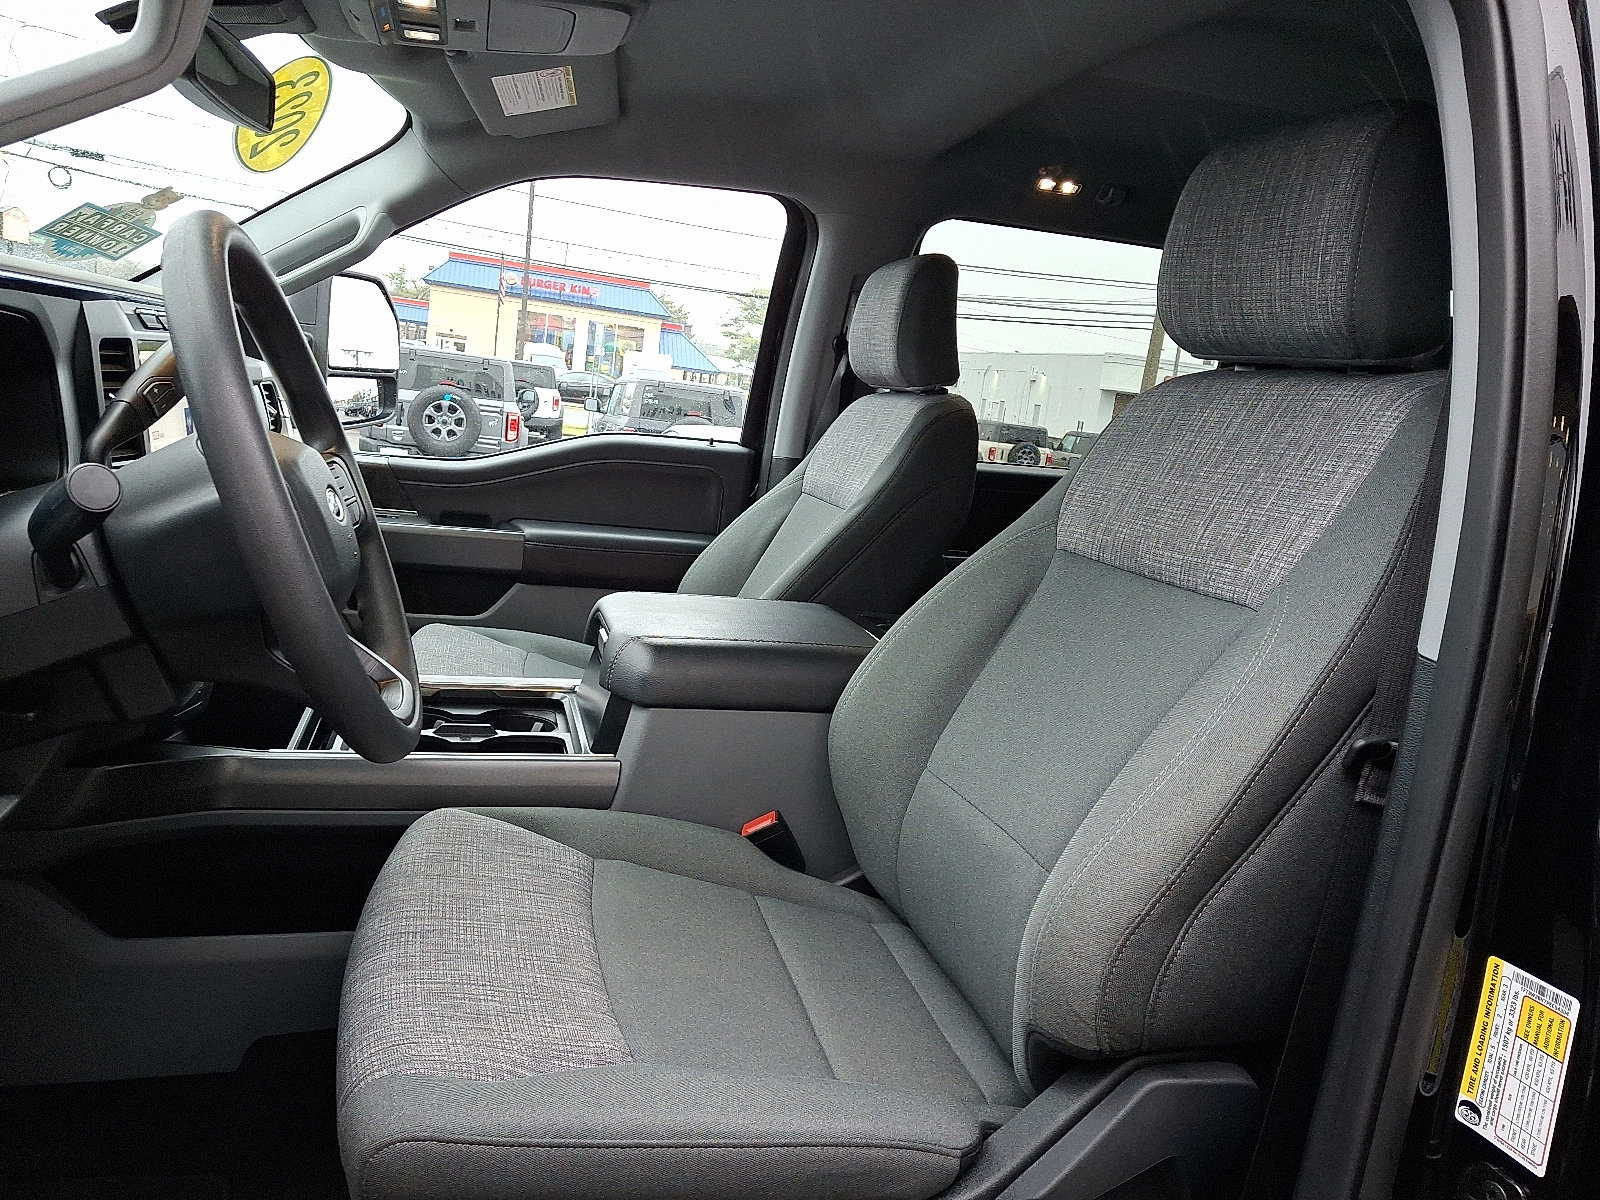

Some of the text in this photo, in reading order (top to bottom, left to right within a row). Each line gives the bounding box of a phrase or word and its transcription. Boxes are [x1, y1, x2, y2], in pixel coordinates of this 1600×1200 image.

[1467, 963, 1500, 1094] TIRE AND LOADING INFORMATION
[1505, 1027, 1512, 1035] kg
[1509, 1001, 1517, 1018] 3323
[1526, 1005, 1534, 1028] OWNERS
[1533, 1023, 1542, 1046] MANUAL
[1543, 1018, 1554, 1050] ADDITIONAL
[1553, 1019, 1565, 1058] INFORMATION
